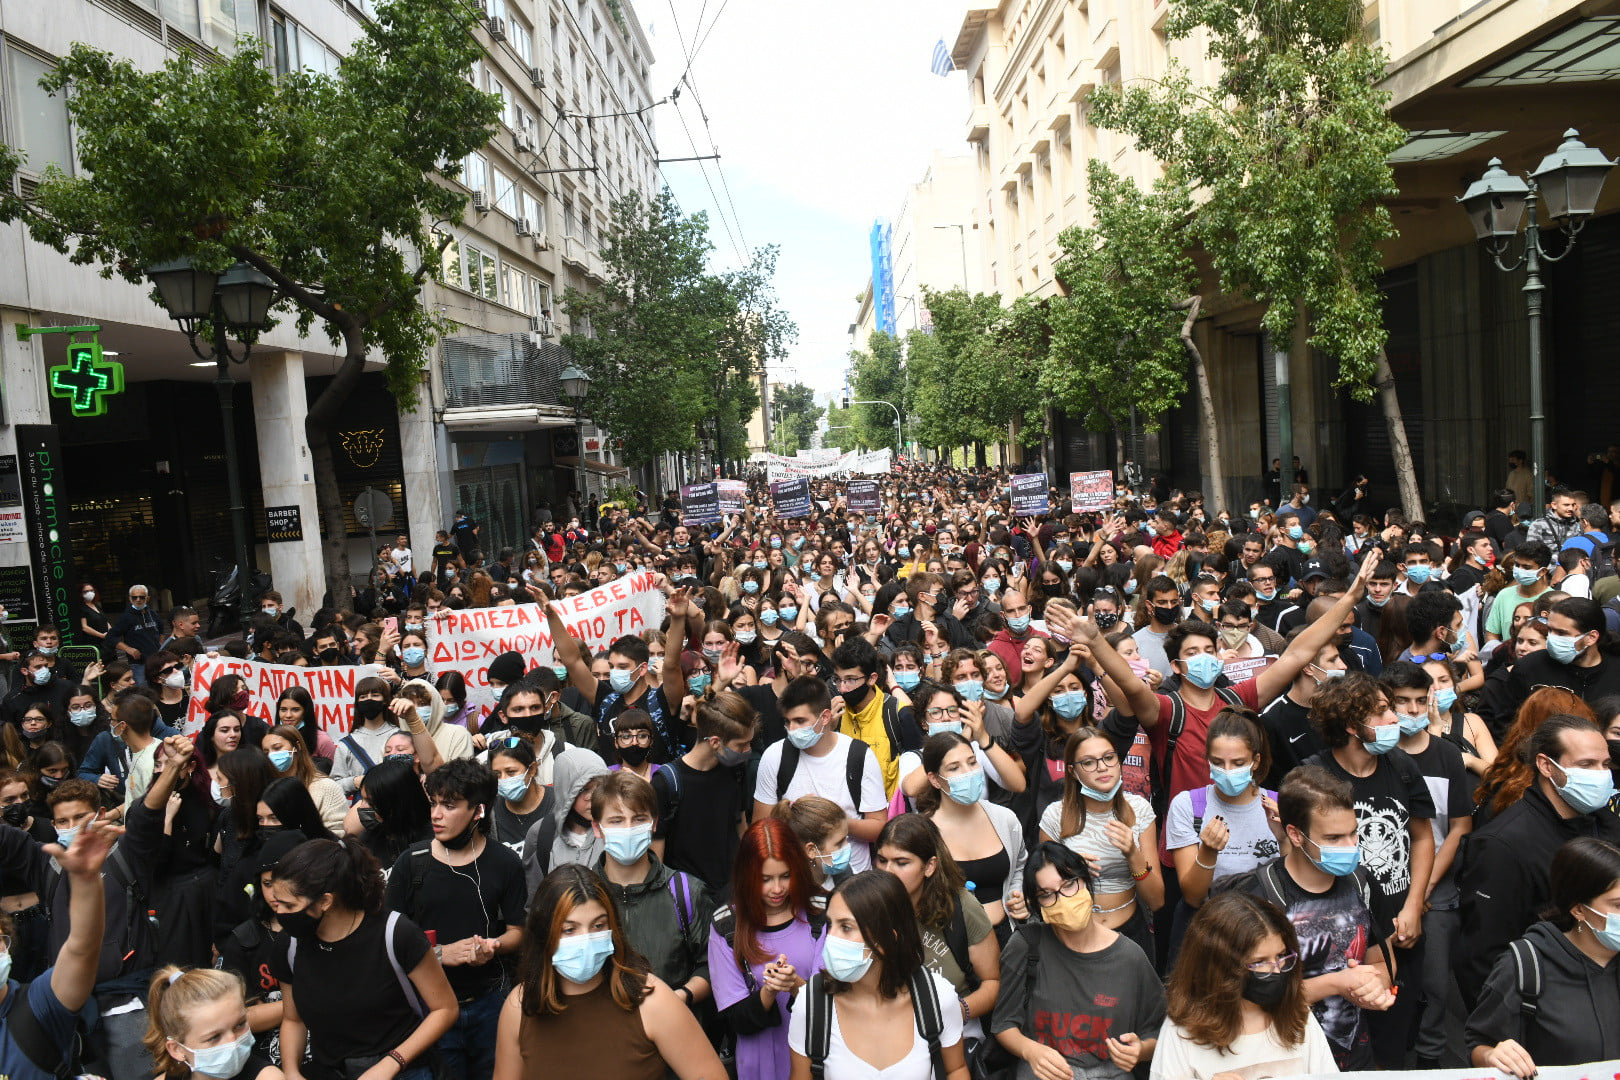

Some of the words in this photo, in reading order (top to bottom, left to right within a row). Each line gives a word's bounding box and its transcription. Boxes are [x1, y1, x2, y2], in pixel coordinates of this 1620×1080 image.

[36, 451, 65, 580] pharmacie
[268, 509, 298, 518] BARBER
[269, 518, 289, 526] SHOP
[432, 607, 531, 636] ΤΡΑΠΕΖΑ
[566, 615, 606, 642] ΑΠΟ
[613, 606, 645, 634] ΤΑ
[303, 668, 355, 699] ΤΗΝ
[922, 931, 950, 957] BEACH
[1035, 1009, 1115, 1043] FUCK
